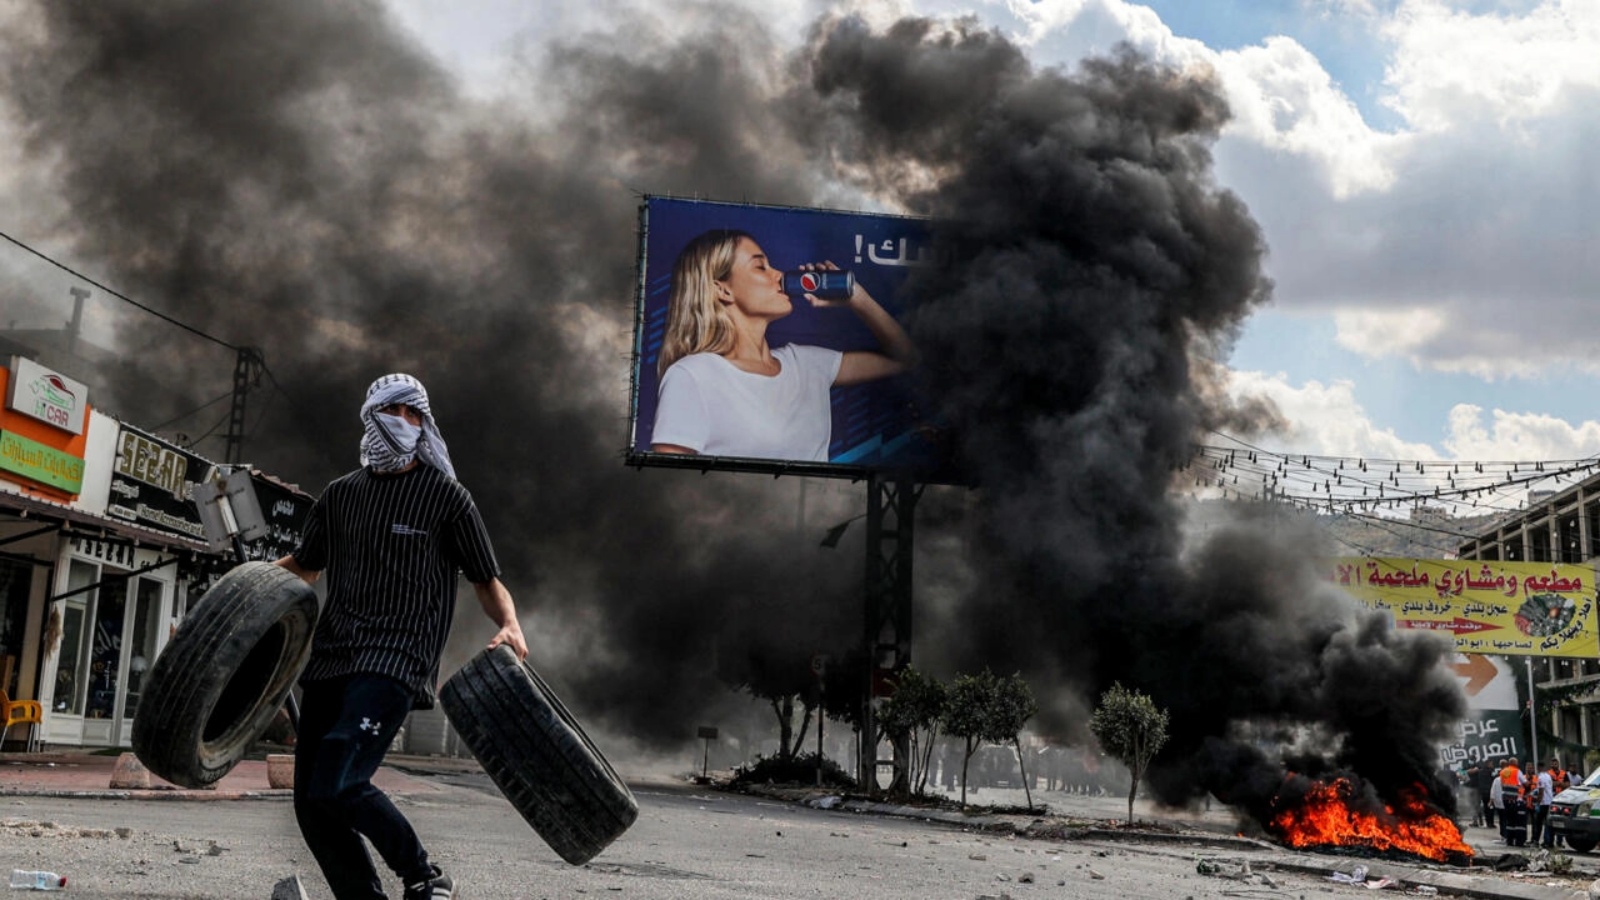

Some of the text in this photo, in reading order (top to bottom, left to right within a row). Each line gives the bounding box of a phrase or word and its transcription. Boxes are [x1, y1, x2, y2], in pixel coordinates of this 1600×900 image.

[47, 406, 69, 427] CAR
[117, 431, 187, 501] SEZAR
[1368, 560, 1430, 587] ملحمة
[1435, 564, 1517, 598] ومشاوي
[1524, 569, 1582, 595] مطعم
[1402, 601, 1424, 615] بلدي
[1425, 600, 1451, 614] خروف
[1463, 603, 1486, 617] بلدي
[1459, 718, 1498, 738] عرض
[1441, 737, 1517, 765] العروض
